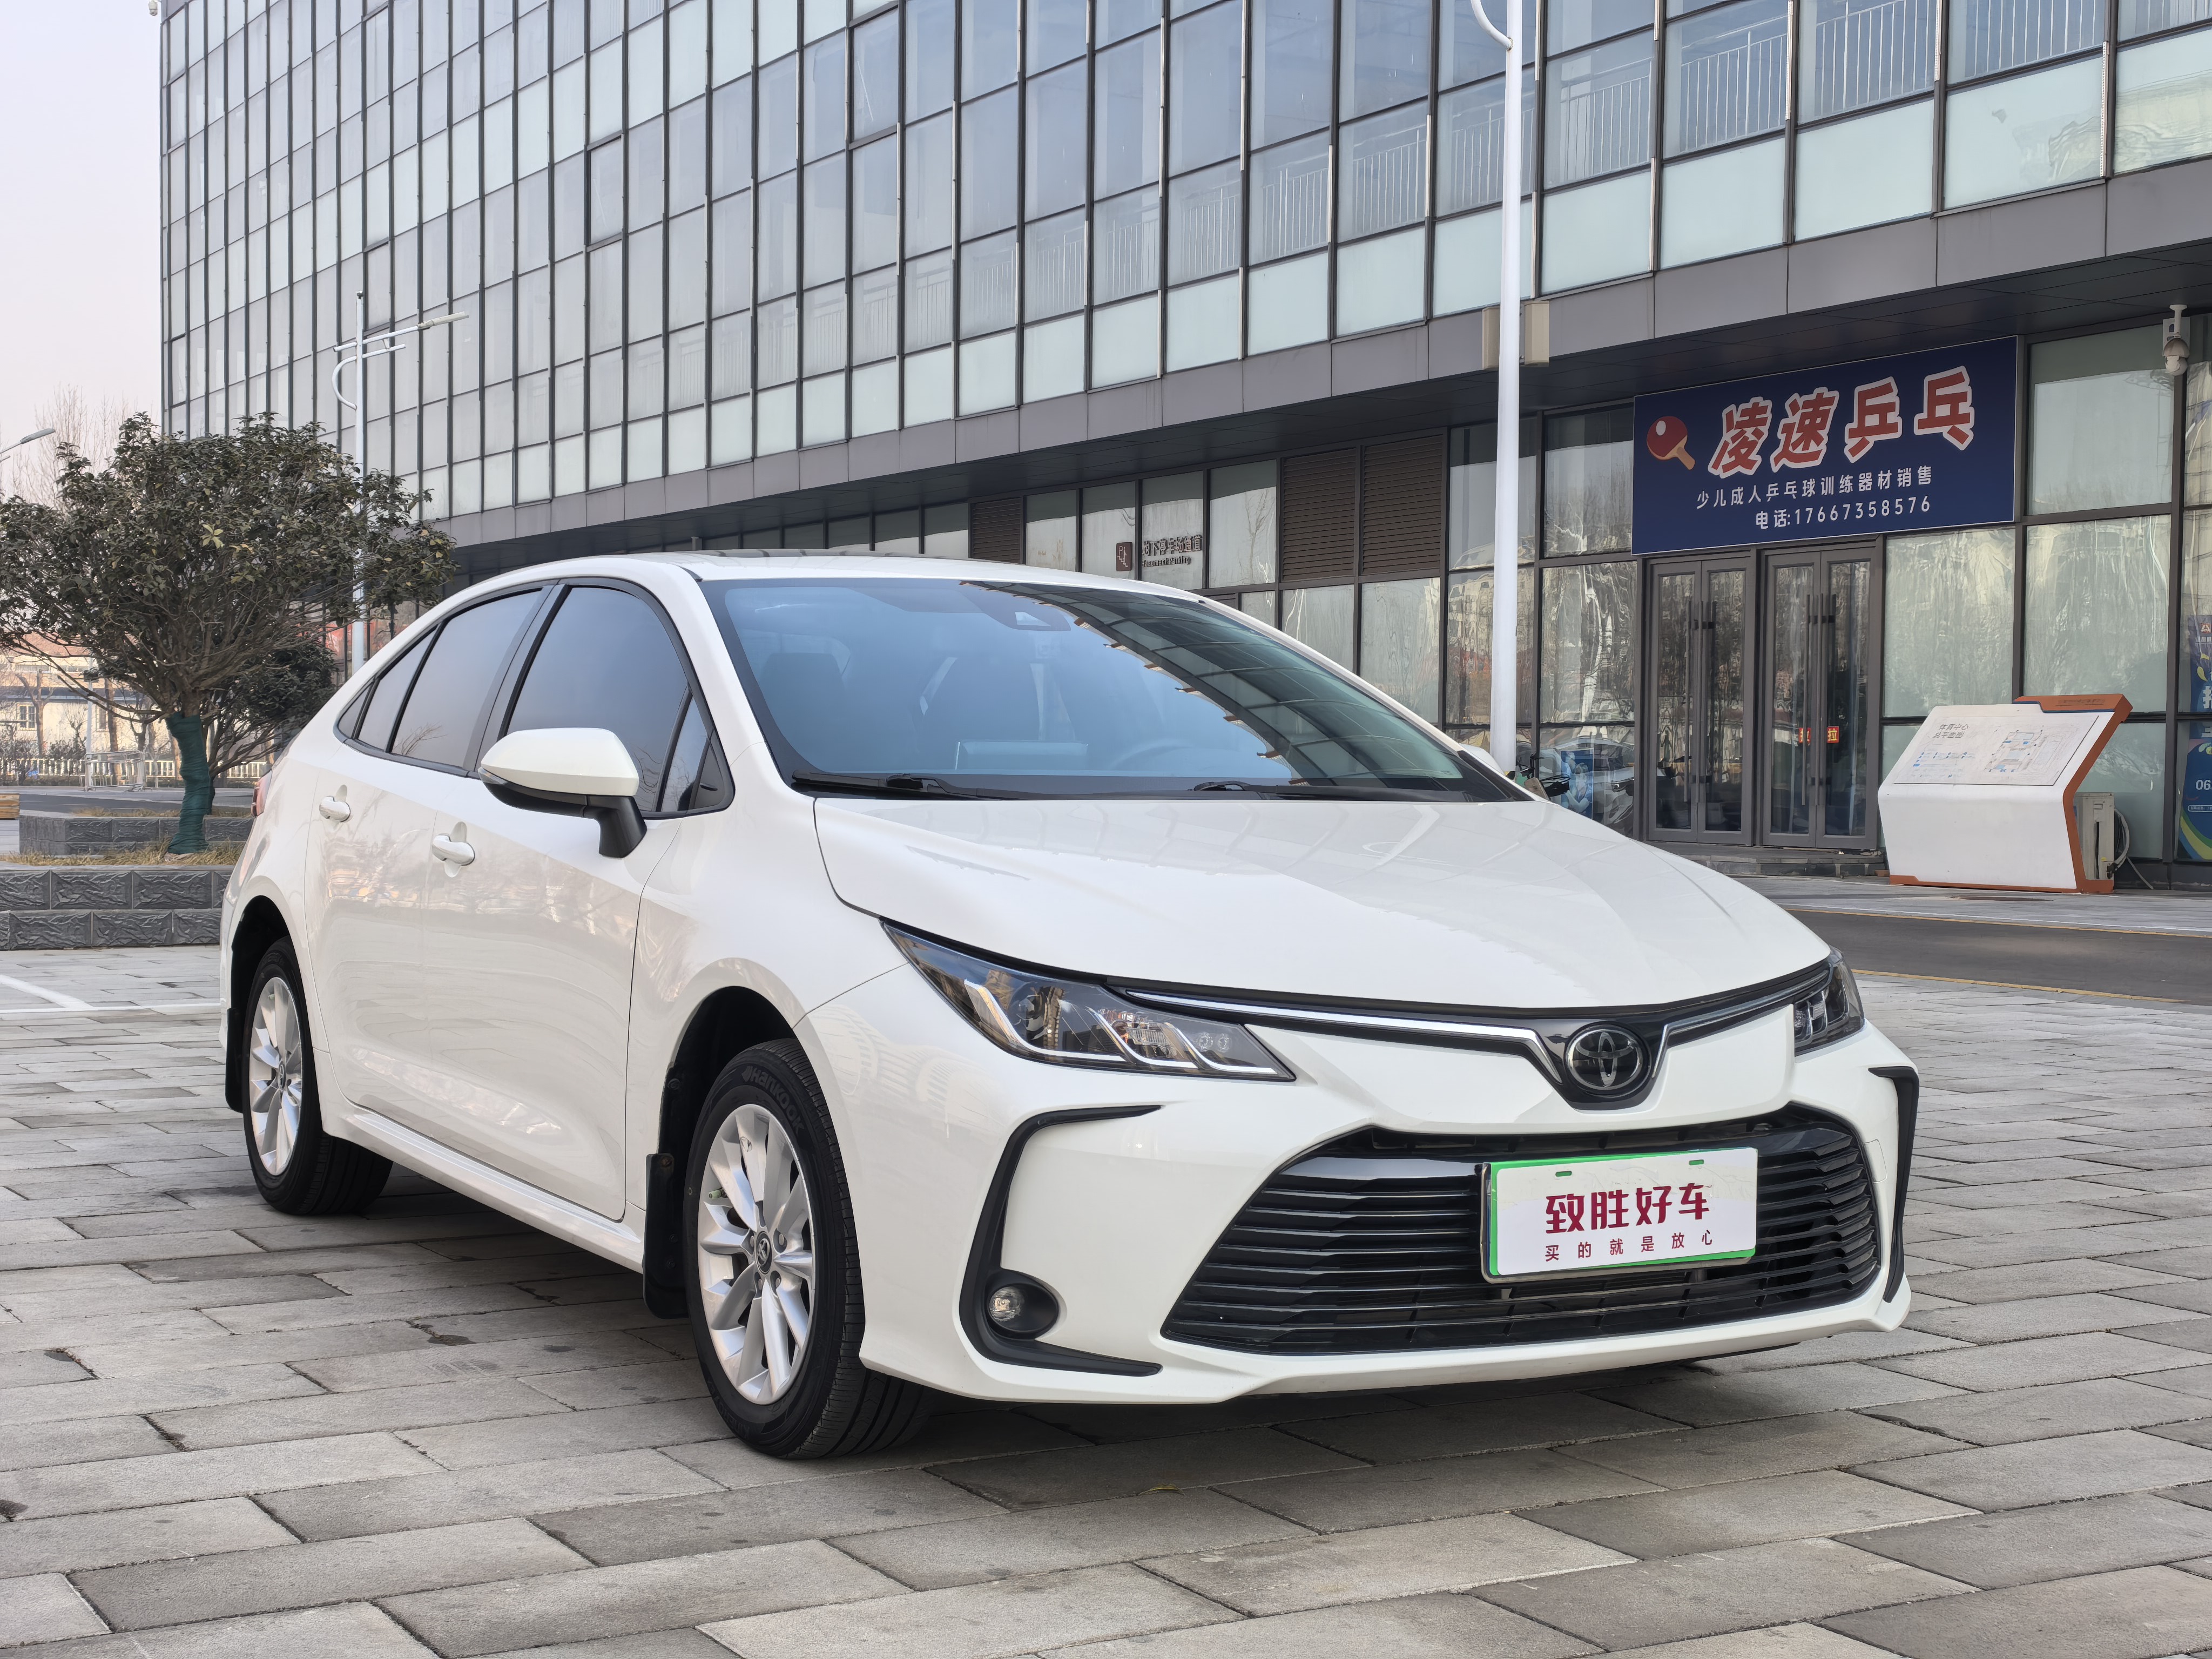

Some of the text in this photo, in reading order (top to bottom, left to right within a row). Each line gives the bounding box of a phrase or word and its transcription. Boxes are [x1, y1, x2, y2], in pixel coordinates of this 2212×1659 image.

[1708, 365, 1974, 479] 凌速乒乓
[1696, 465, 1932, 510] 少儿成人乒乓球训练器材销售
[1756, 495, 1931, 529] 电话:17667358576
[1827, 727, 1837, 741] 拉
[2195, 779, 2212, 790] 06
[1545, 1182, 1710, 1235] 致胜好车
[1545, 1229, 1714, 1262] 买的就是放心
